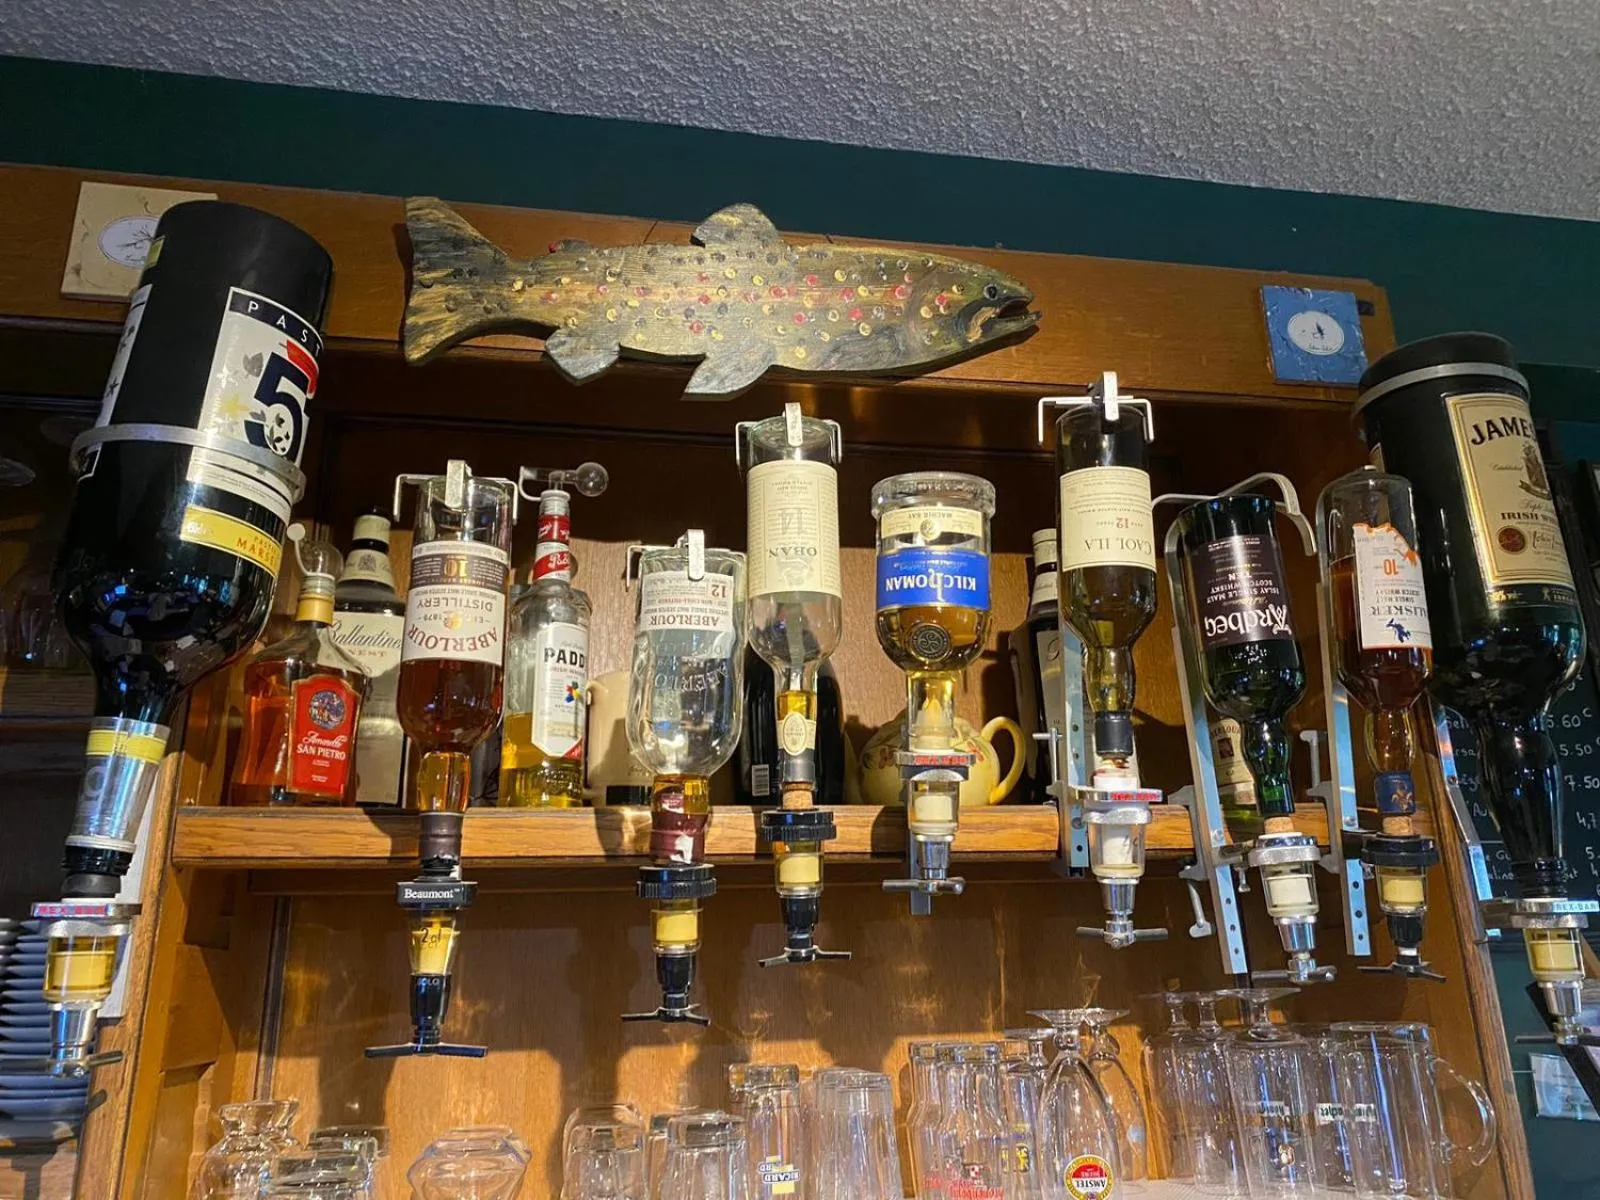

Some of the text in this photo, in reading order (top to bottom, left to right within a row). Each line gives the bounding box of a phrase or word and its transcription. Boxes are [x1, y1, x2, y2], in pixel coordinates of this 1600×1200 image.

[1115, 517, 1129, 529] 12
[1500, 511, 1539, 521] IRISH
[768, 546, 818, 558] OBAN
[1084, 538, 1152, 555] CAOL ILA
[1383, 558, 1399, 577] 10
[711, 584, 728, 599] 12
[1228, 587, 1259, 600] SILE
[415, 596, 494, 613] DISTILLERY
[649, 614, 720, 627] ABERLOUR
[406, 623, 499, 653] ABERLOUR
[543, 647, 585, 669] PADD
[296, 745, 346, 761] SAN PIETRO
[404, 887, 455, 900] Beaumont
[1074, 1179, 1106, 1189] AMSTEL
